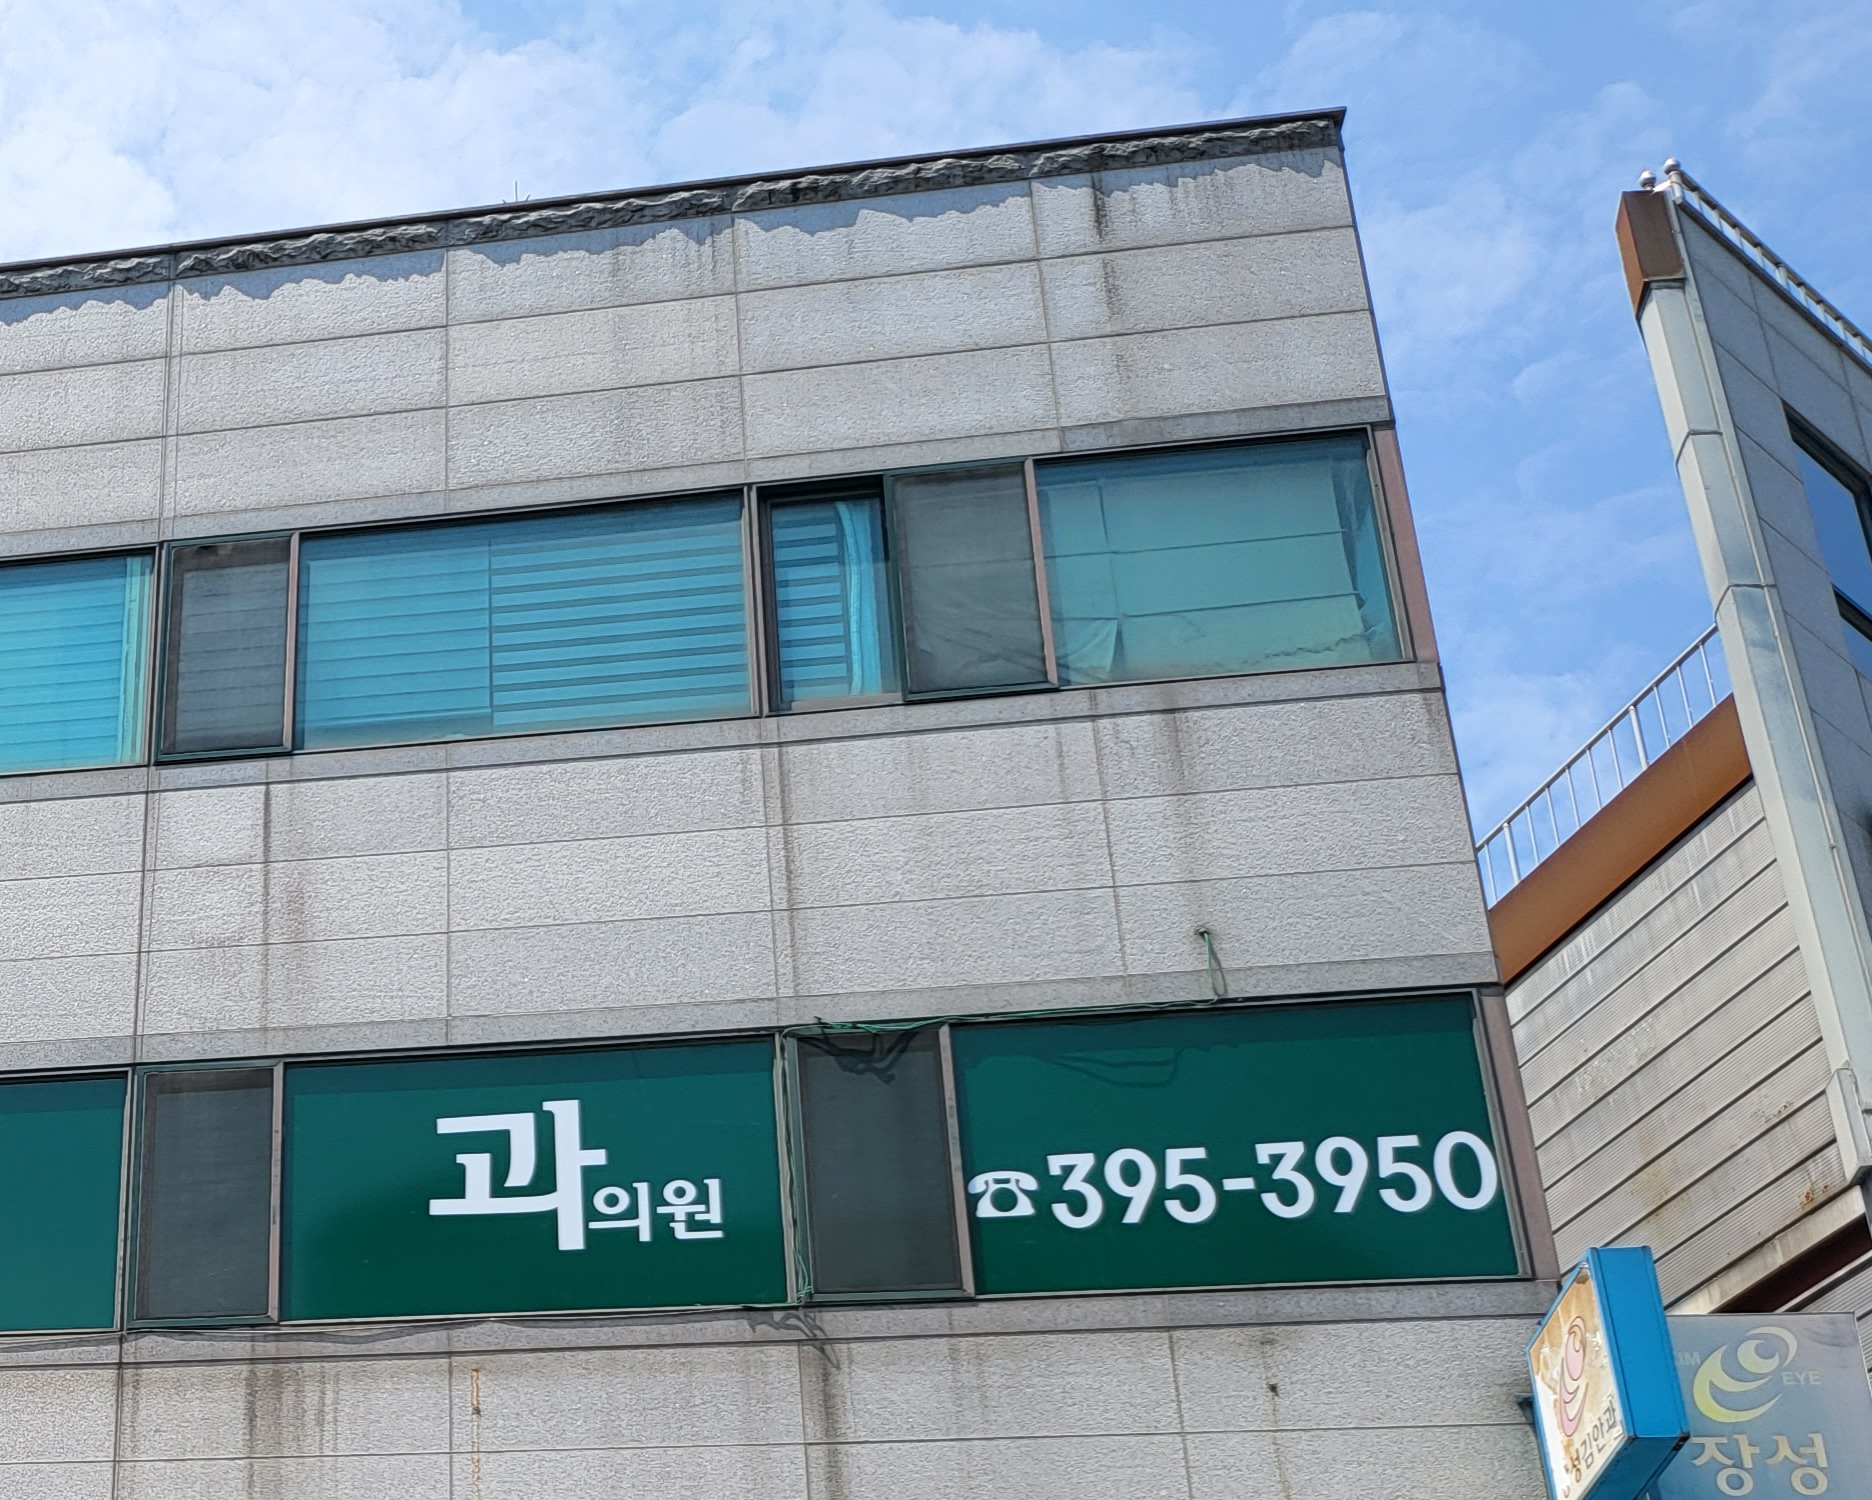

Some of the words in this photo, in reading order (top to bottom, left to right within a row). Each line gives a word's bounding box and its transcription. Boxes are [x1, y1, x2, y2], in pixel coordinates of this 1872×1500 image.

[589, 1178, 724, 1241] 의원
[1048, 1129, 1500, 1229] 395-3950
[1781, 1370, 1822, 1385] EYE
[1692, 1433, 1828, 1497] 장성
